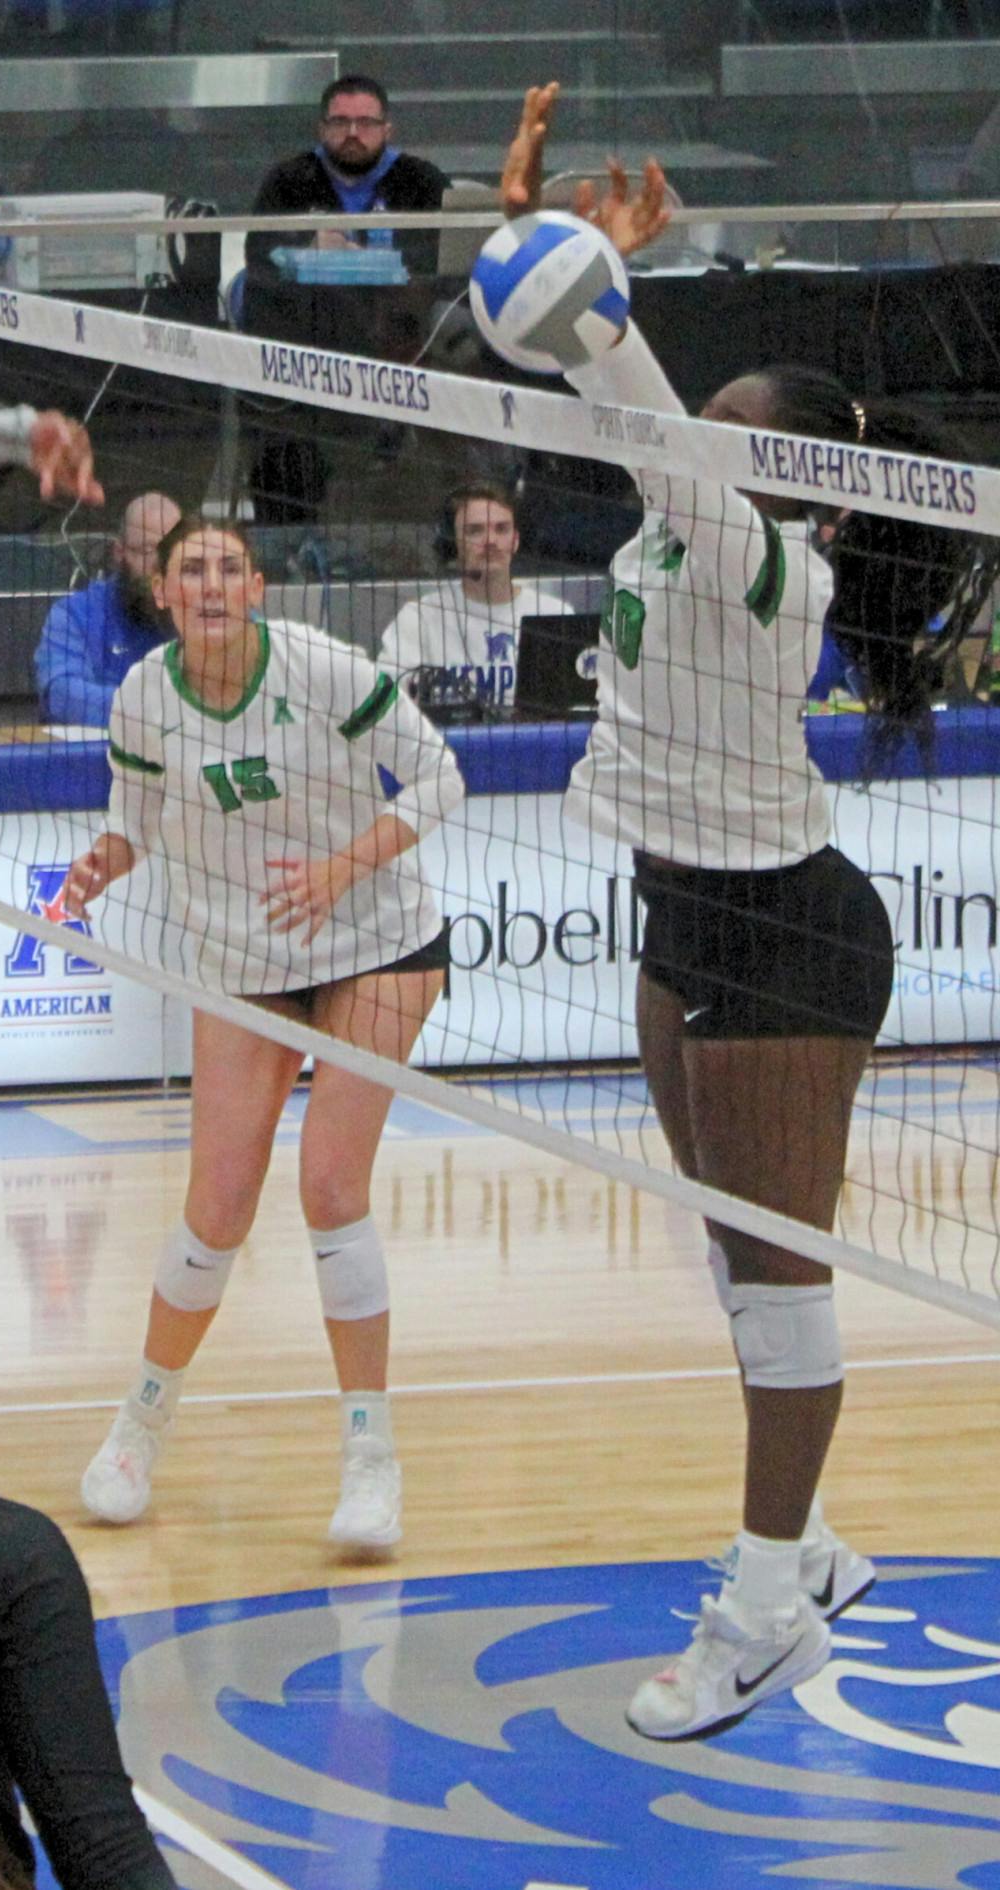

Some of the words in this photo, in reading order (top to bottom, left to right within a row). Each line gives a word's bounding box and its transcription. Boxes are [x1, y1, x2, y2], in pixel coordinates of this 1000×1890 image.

[261, 343, 353, 398] MEMPHIS
[355, 361, 430, 411] TIGERS
[749, 433, 872, 497] MEMPHIS
[876, 455, 977, 515] TIGERS
[440, 665, 513, 705] MEMP
[202, 755, 281, 813] 15
[443, 875, 641, 1001] pbell
[863, 864, 998, 952] lin
[0, 994, 113, 1019] AMERICAN
[891, 970, 1000, 998] HOPAE
